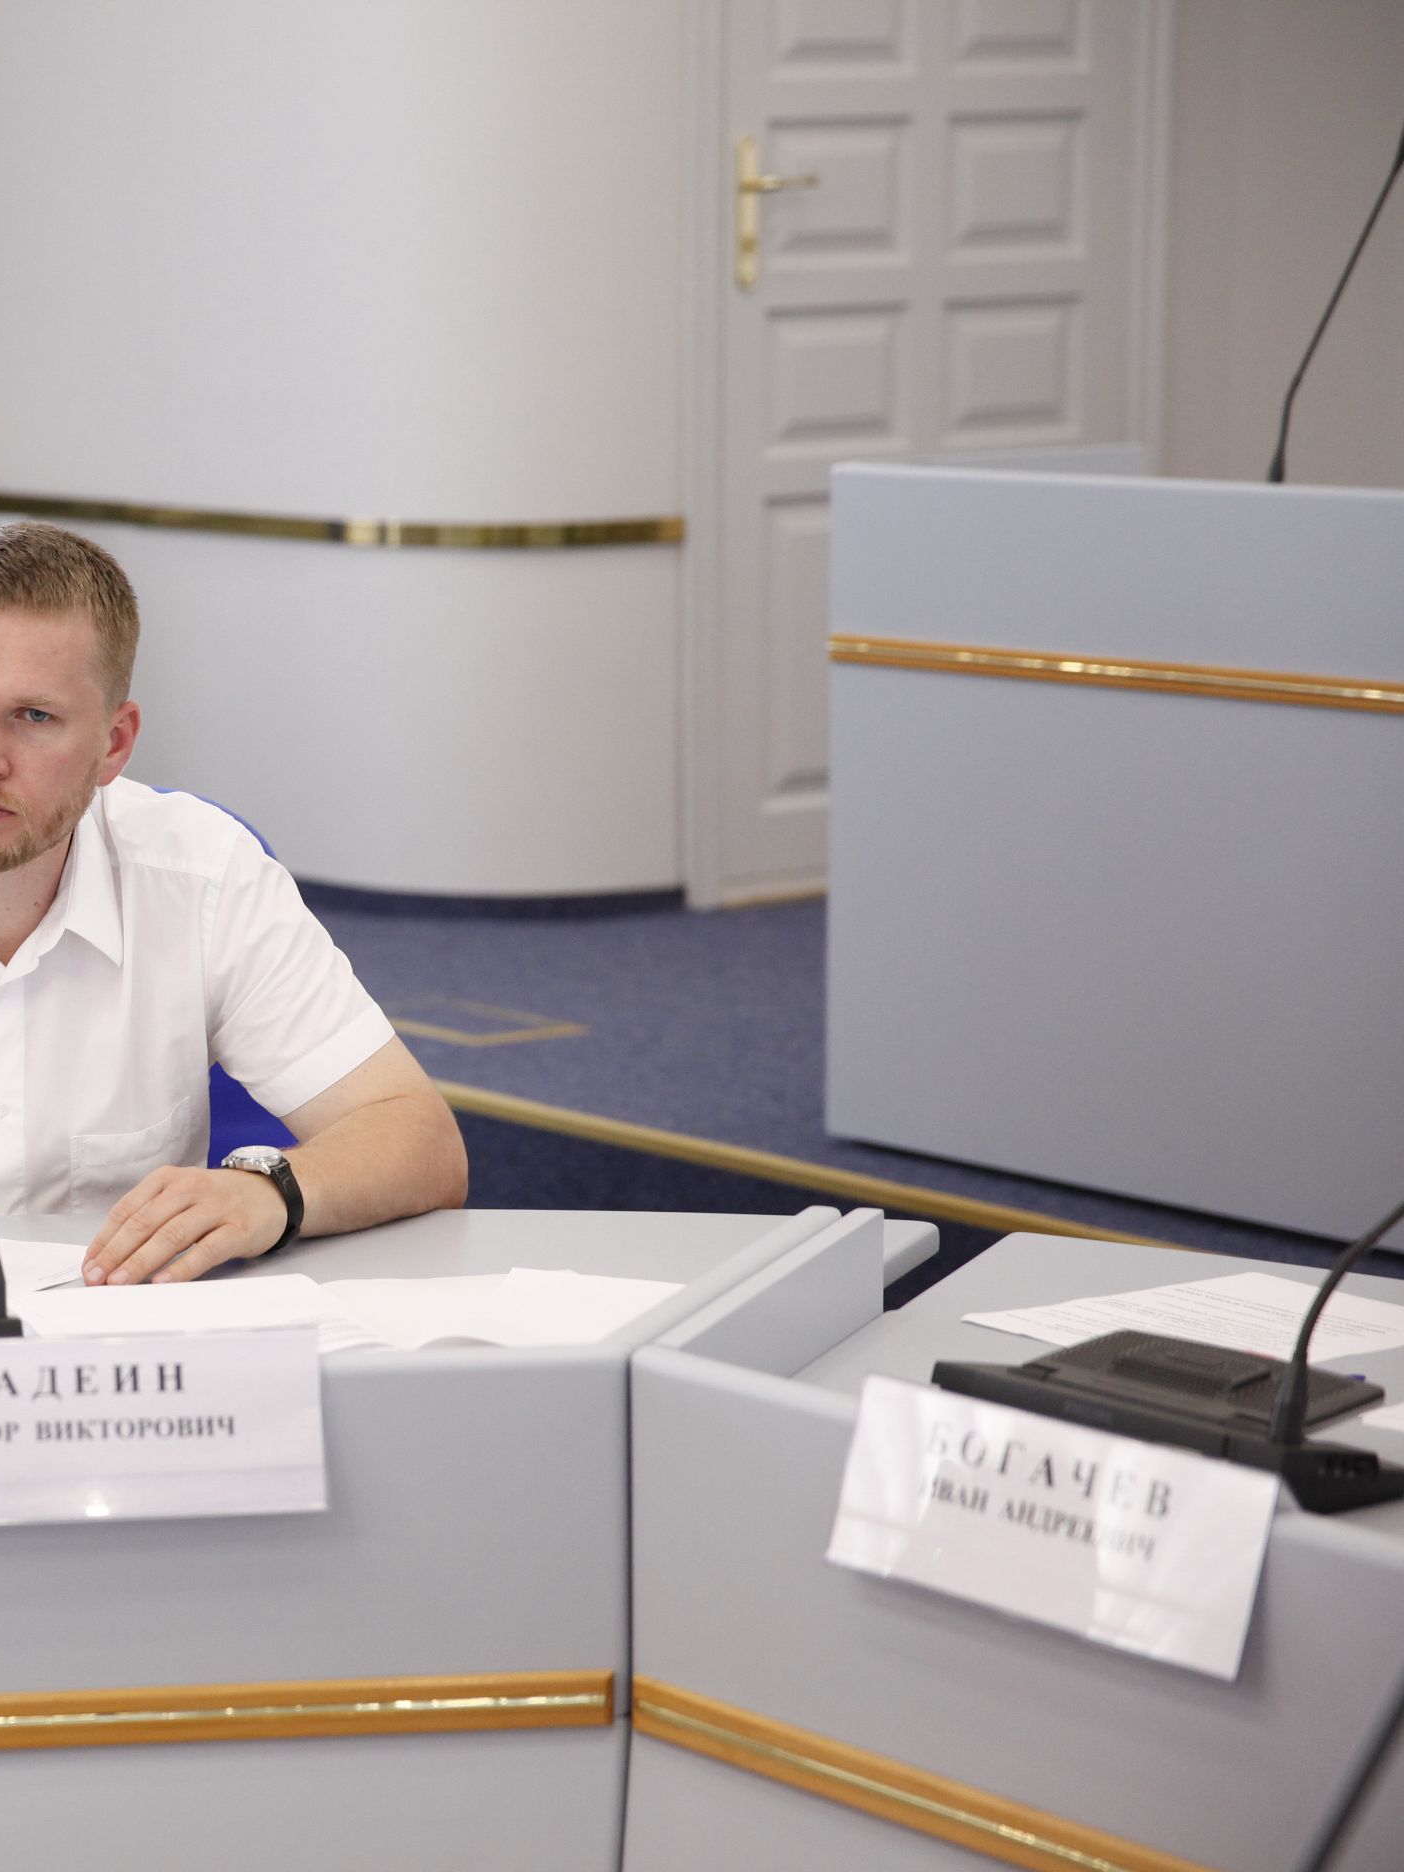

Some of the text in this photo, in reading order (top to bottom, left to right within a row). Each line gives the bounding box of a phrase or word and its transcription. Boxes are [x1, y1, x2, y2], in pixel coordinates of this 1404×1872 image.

[34, 1415, 236, 1443] ВИКТОРОВИЧ
[927, 1420, 1174, 1518] БОГАЧЕВ
[998, 1498, 1157, 1562] АНДРЕЕИЧ
